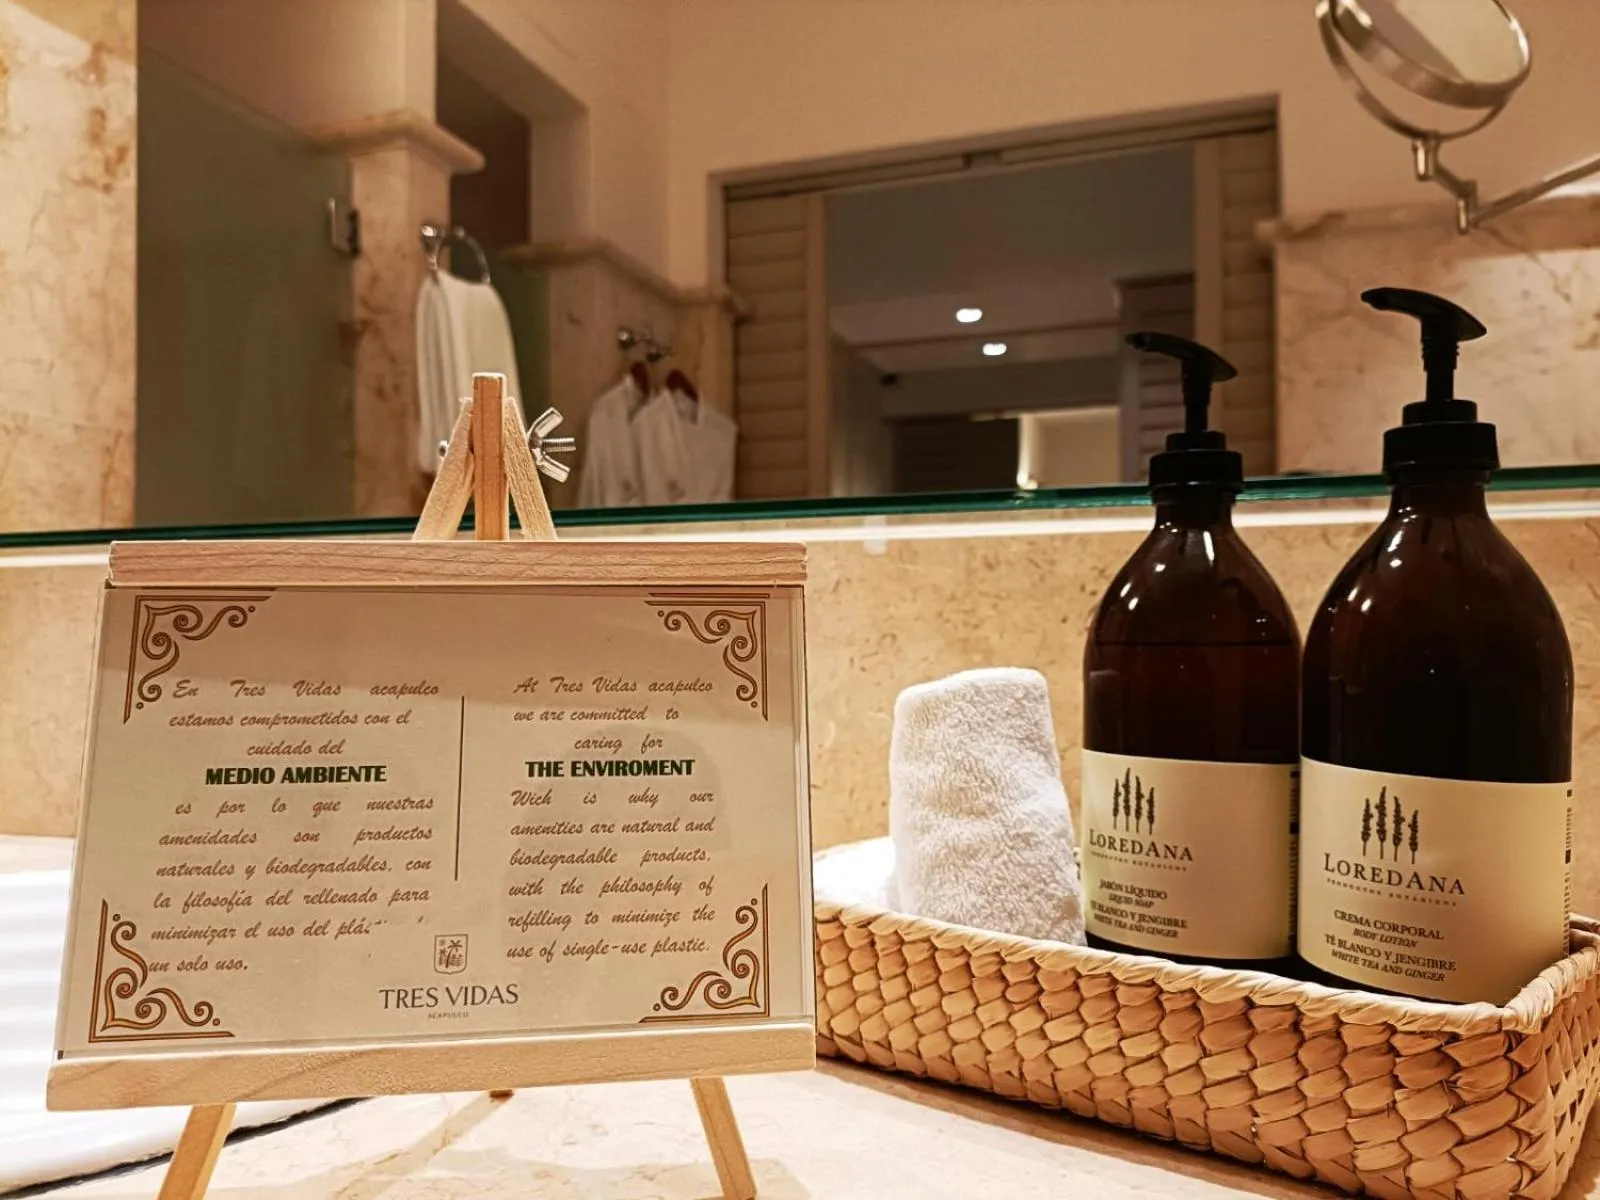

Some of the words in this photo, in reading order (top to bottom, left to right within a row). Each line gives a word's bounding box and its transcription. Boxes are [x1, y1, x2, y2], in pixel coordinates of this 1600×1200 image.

[173, 680, 198, 698] En
[230, 679, 266, 698] Tres
[293, 679, 342, 697] Vidas
[369, 684, 440, 700] acapulco
[513, 677, 539, 693] At
[550, 676, 583, 692] Tres
[592, 676, 638, 692] Vidas
[648, 677, 713, 695] acapulco
[169, 713, 234, 727] estamos
[240, 709, 358, 731] comprometidos
[364, 713, 390, 725] con
[396, 709, 412, 725] el
[513, 711, 534, 721] we
[540, 711, 565, 721] are
[570, 706, 648, 721] committed
[665, 707, 679, 720] to
[247, 740, 312, 756] cuidado
[318, 739, 345, 755] del
[574, 737, 623, 754] caring
[641, 733, 663, 753] for
[205, 766, 275, 785] MEDIO
[281, 765, 387, 784] AMBIENTE
[525, 761, 564, 778] THE
[571, 759, 696, 777] ENVIROMENT
[175, 802, 192, 814] es
[216, 800, 246, 818] por
[272, 797, 287, 813] lo
[312, 800, 342, 817] que
[366, 797, 434, 811] nuestras
[511, 789, 552, 806] Wich
[583, 791, 597, 804] is
[628, 787, 660, 808] why
[689, 792, 714, 802] our
[158, 829, 257, 846] amenidades
[293, 831, 320, 843] son
[353, 827, 433, 845] productos
[510, 821, 584, 836] amenities
[590, 824, 615, 834] are
[622, 817, 680, 833] natural
[685, 817, 716, 832] and
[1089, 829, 1193, 862] LOREDANA
[510, 847, 618, 870] biodegradable
[156, 860, 234, 877] naturales
[245, 863, 256, 880] y
[405, 859, 432, 871] con
[1324, 853, 1465, 895] LOREDANA
[509, 878, 544, 896] with
[561, 877, 584, 895] the
[598, 875, 682, 897] philosophy
[699, 875, 715, 896] of
[1125, 884, 1167, 900] LÍQUIDO
[153, 892, 171, 909] la
[182, 890, 253, 914] filosofía
[265, 889, 293, 906] del
[303, 887, 378, 905] rellenado
[388, 889, 430, 906] para
[508, 910, 572, 933] refilling
[584, 911, 599, 924] to
[611, 909, 680, 927] minimize
[692, 904, 715, 921] the
[1130, 911, 1137, 920] Y
[1137, 913, 1188, 929] JENGIBRE
[1334, 909, 1371, 927] CREMA
[1373, 920, 1444, 940] CORPORAL
[151, 923, 237, 945] minimizar
[244, 922, 260, 938] el
[267, 925, 295, 936] uso
[303, 919, 331, 936] del
[1353, 928, 1377, 940] BODY
[1379, 934, 1418, 948] LOTION
[507, 946, 533, 958] use
[539, 941, 557, 963] of
[562, 939, 646, 961] single-use
[650, 936, 710, 957] plastic.
[1325, 933, 1337, 946] TÉ
[1338, 938, 1381, 958] BLANCO
[1383, 951, 1393, 961] Y
[1392, 953, 1456, 971] JENGIBRE
[148, 958, 170, 973] un
[177, 954, 208, 971] solo
[215, 958, 248, 971] uso.
[1331, 949, 1360, 966] WHITE
[1362, 958, 1379, 970] TEA
[1381, 964, 1403, 975] AND
[1405, 968, 1446, 982] GINGER
[379, 987, 439, 1009] TRES
[445, 983, 519, 1006] VIDAS
[428, 1011, 469, 1019] ACAPULCO
